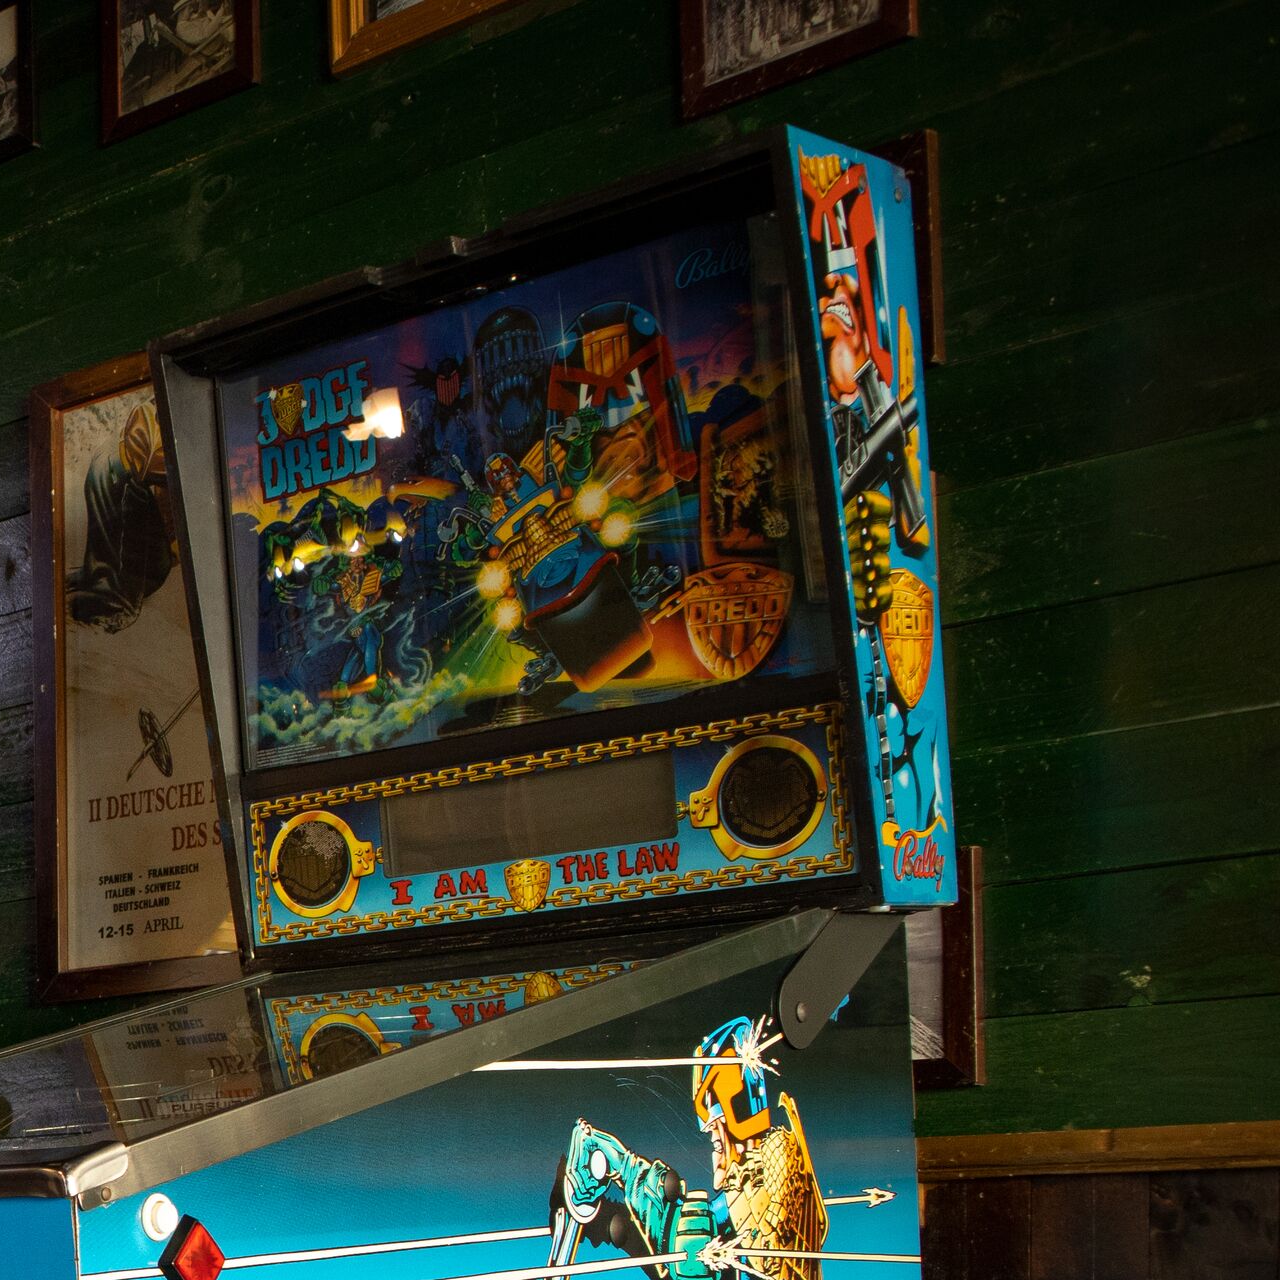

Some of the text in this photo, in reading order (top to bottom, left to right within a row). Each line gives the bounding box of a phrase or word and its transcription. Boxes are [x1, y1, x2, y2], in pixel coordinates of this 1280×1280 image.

[689, 593, 786, 624] DREDD
[88, 798, 101, 823] II
[106, 780, 205, 820] DEUTSCHE
[172, 823, 208, 851] DES
[98, 871, 133, 886] SPANIEN
[148, 862, 199, 879] FRANKREICH
[390, 841, 680, 905] I AM THE LAW
[893, 831, 945, 892] Bally
[105, 886, 135, 899] ITALIEN
[145, 880, 181, 893] SCHWEIZ
[113, 896, 170, 913] DEUTSCHLAND
[98, 916, 184, 939] 12-15 APRIL
